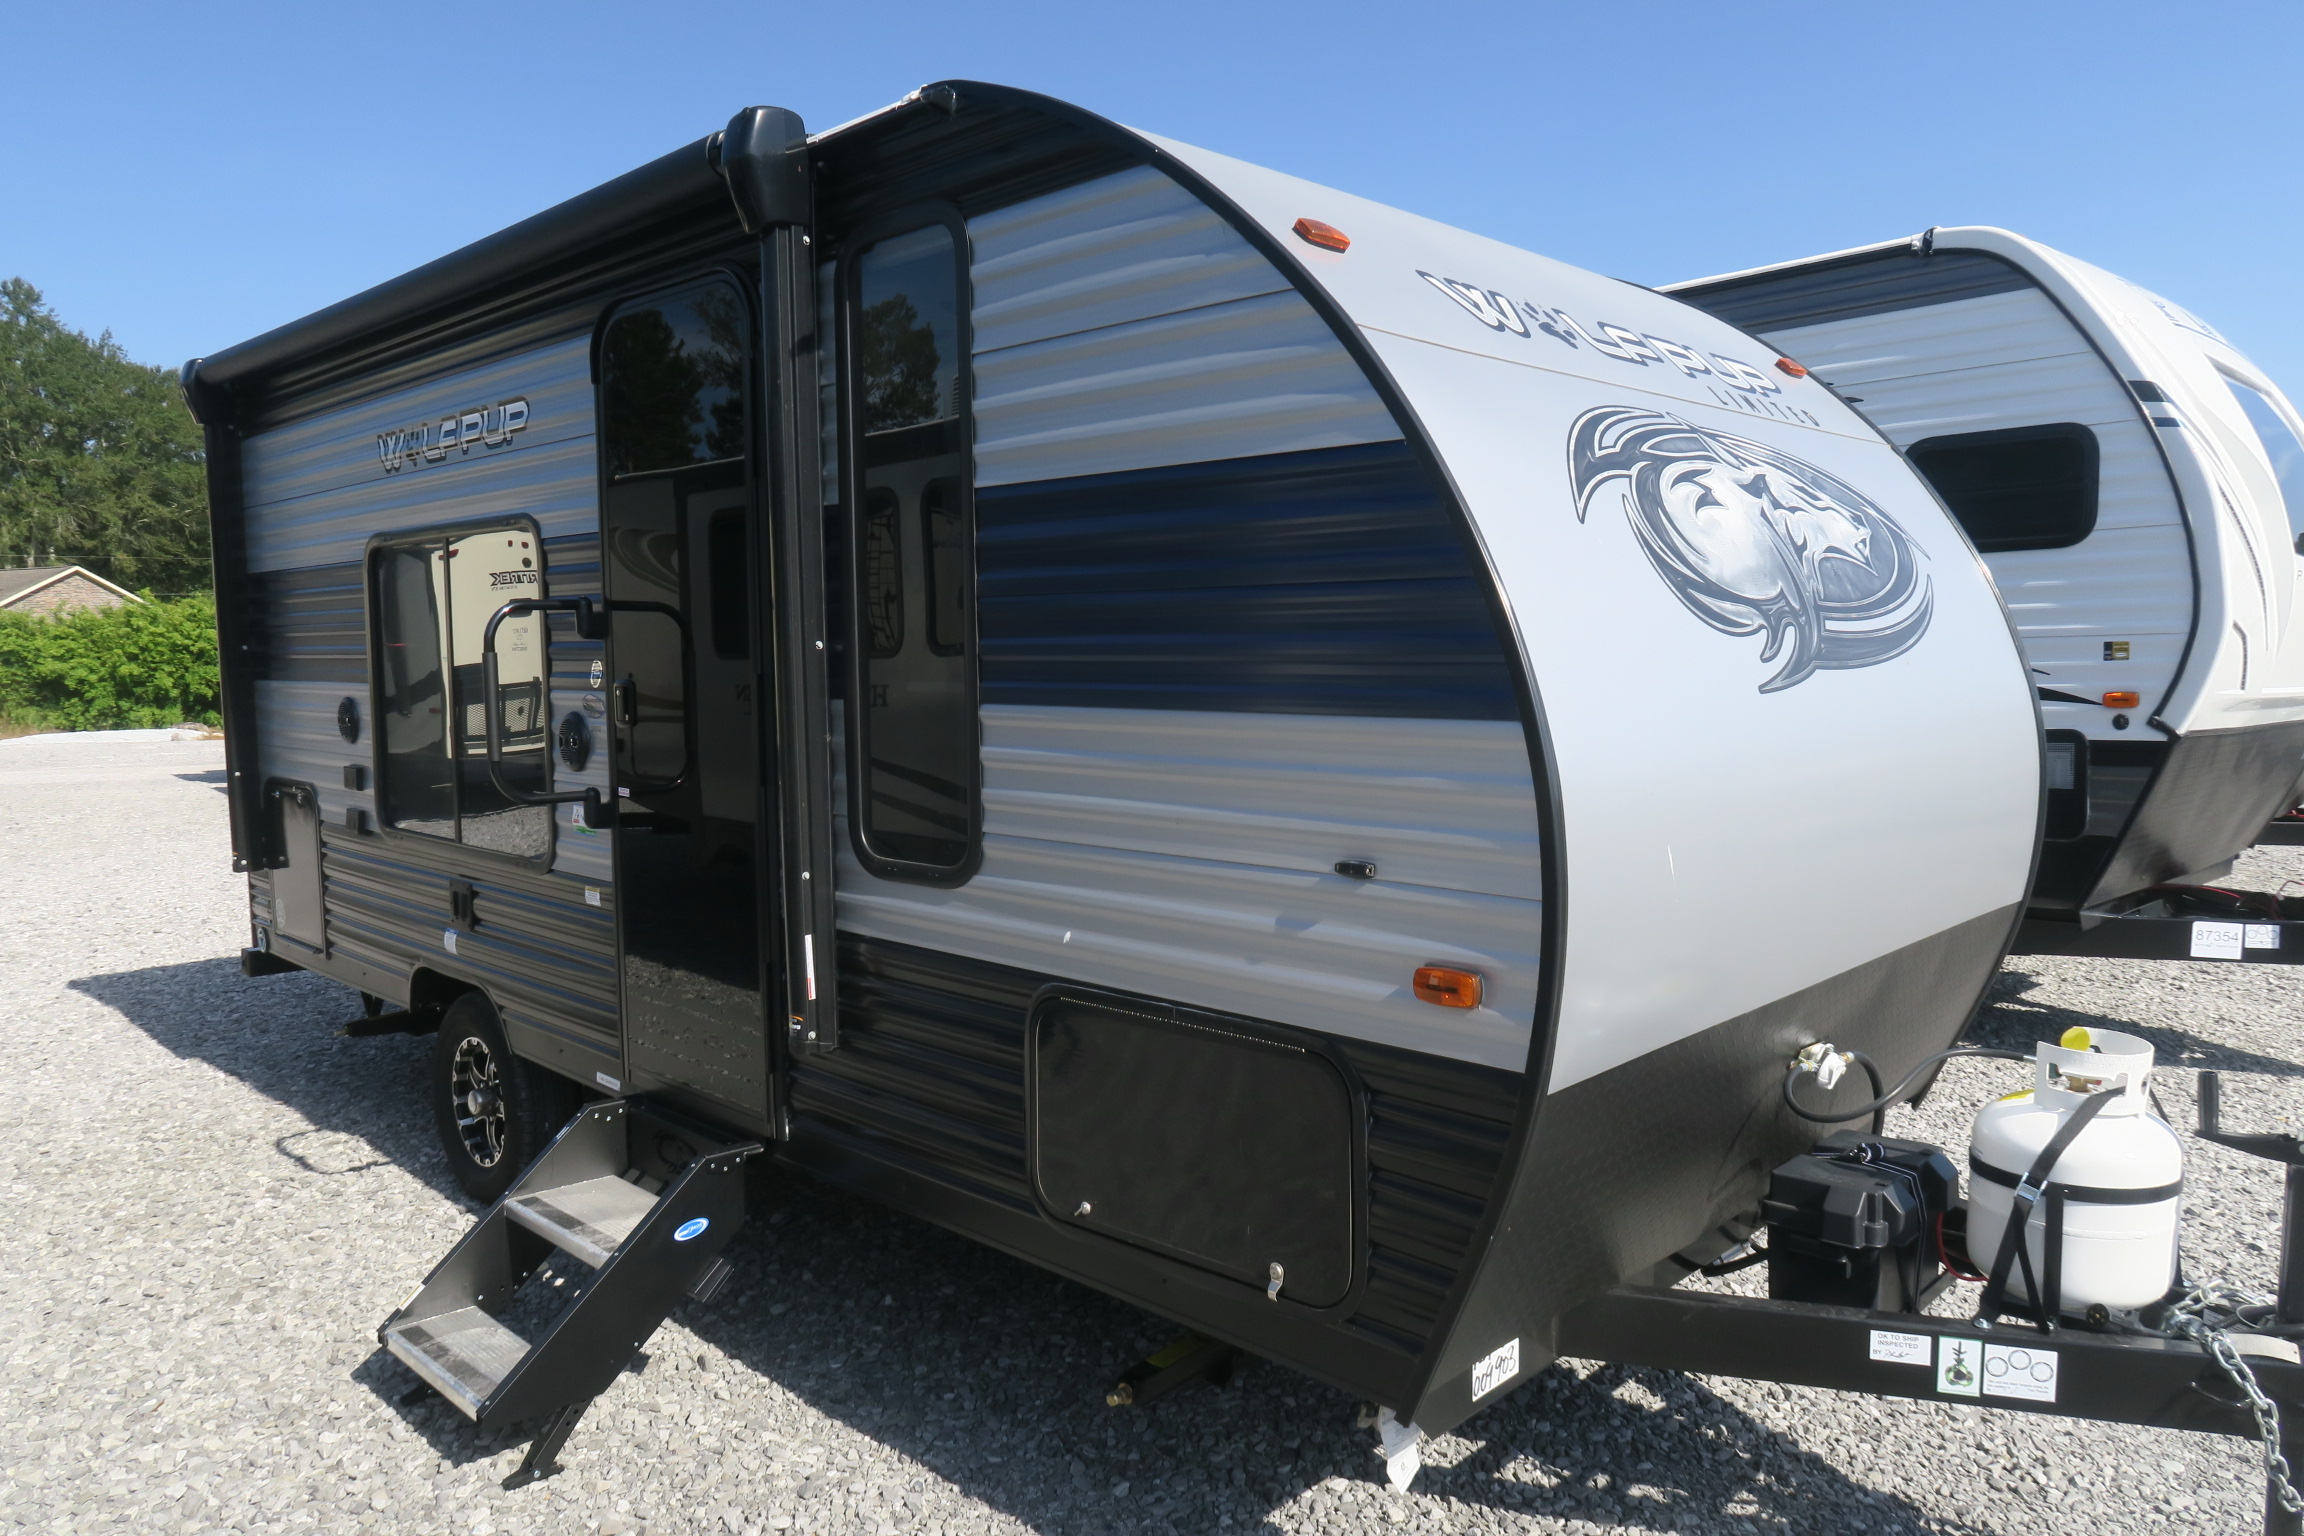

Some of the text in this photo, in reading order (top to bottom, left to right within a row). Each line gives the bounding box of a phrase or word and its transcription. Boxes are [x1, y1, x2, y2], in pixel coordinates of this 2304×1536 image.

[1706, 386, 1820, 427] LIMITED
[2195, 929, 2239, 943] 87354
[1877, 1340, 1919, 1350] INSPECTED
